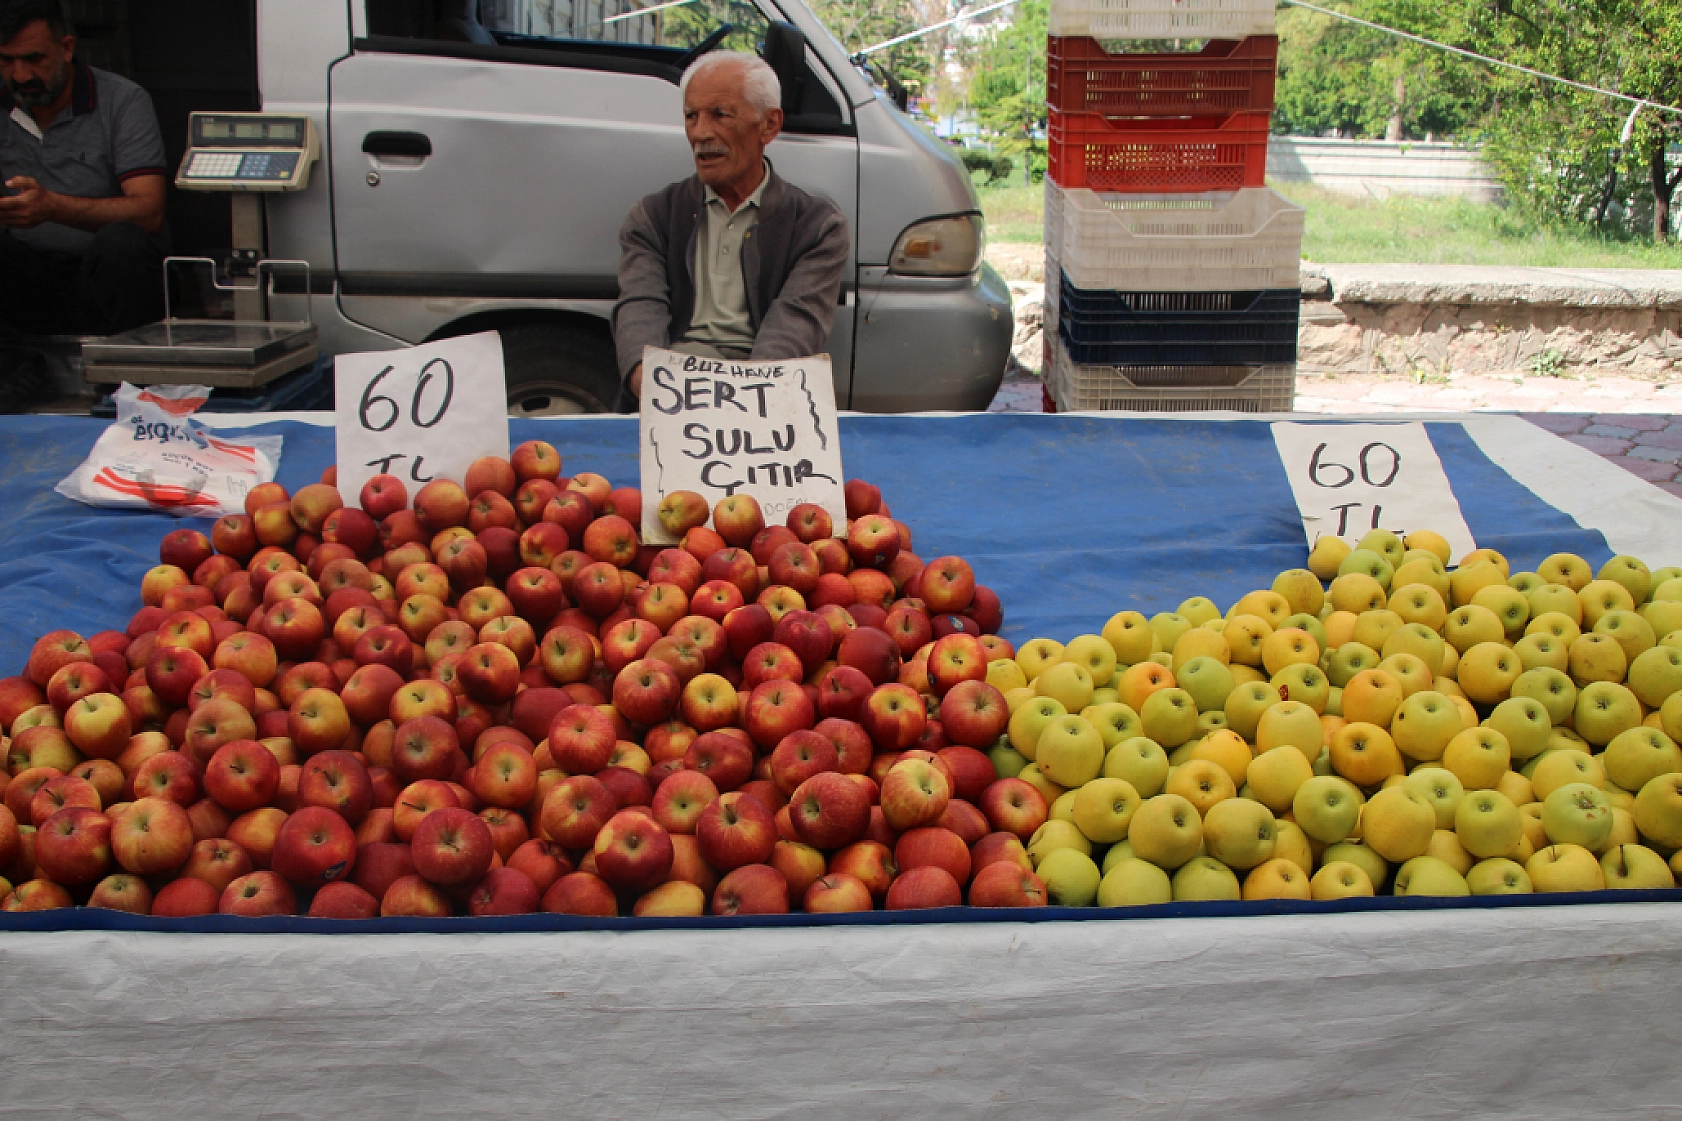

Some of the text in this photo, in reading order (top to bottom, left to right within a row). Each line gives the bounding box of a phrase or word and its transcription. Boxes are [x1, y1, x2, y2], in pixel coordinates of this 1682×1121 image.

[358, 357, 454, 432] 60
[651, 366, 776, 419] SERT
[682, 423, 796, 460] SULU
[365, 453, 434, 482] TL
[1308, 442, 1402, 488] 60
